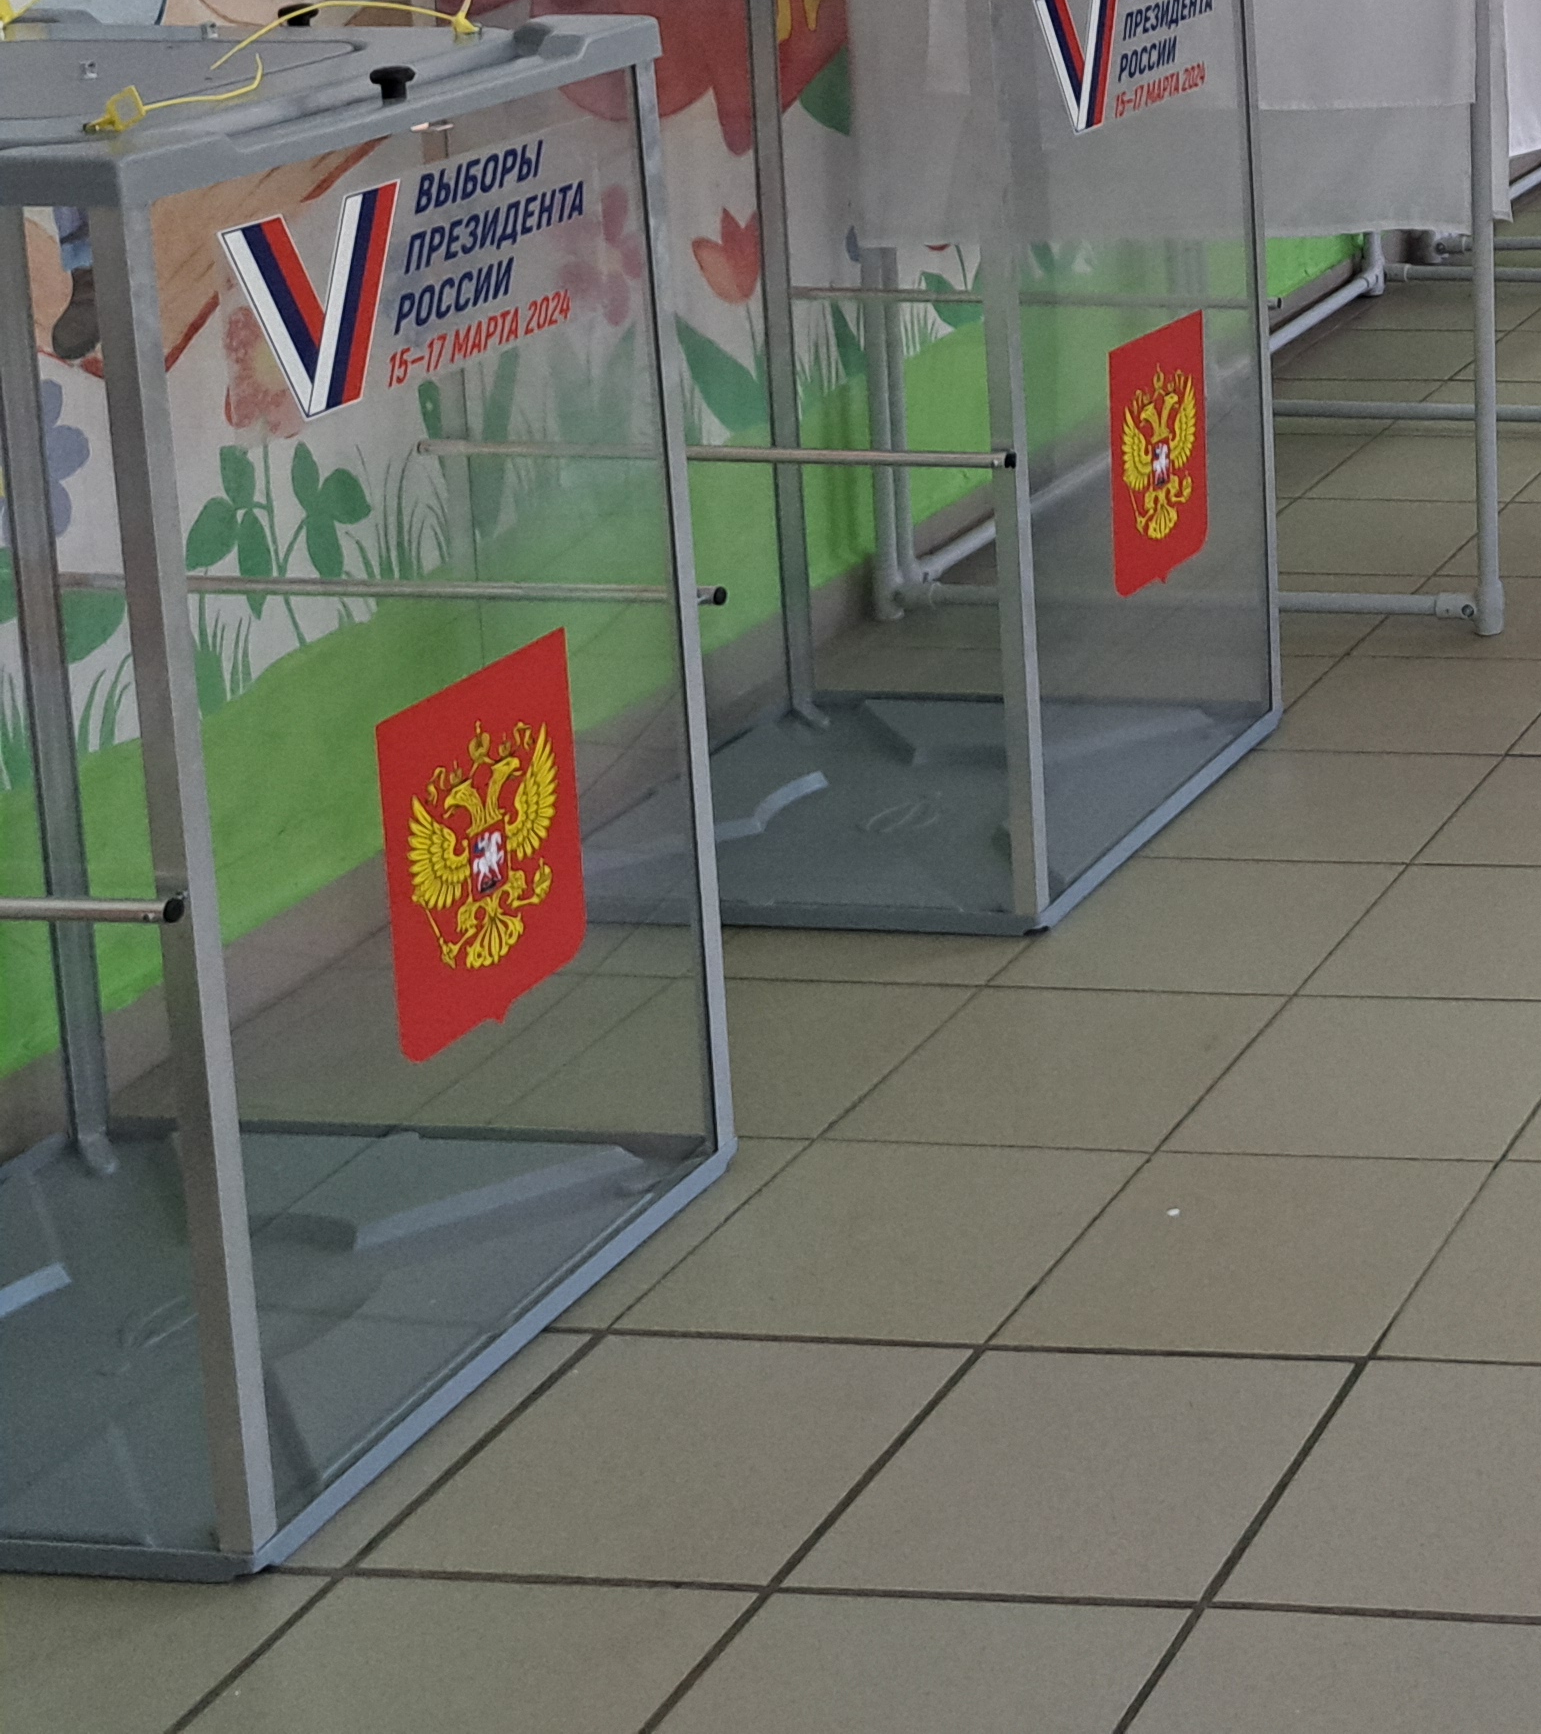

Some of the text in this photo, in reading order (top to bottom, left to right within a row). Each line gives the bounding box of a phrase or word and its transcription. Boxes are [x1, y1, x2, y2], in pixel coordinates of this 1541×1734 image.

[1118, 35, 1178, 83] РОССИИ
[1145, 72, 1180, 107] МАРТА
[1181, 61, 1207, 92] 2024
[414, 139, 544, 215] ВЫБОРЫ
[403, 180, 585, 275] ПРЕЗИДЕНТА
[393, 255, 515, 336] РОССИИ
[449, 306, 520, 364] МАРТА
[523, 288, 572, 336] 2024
